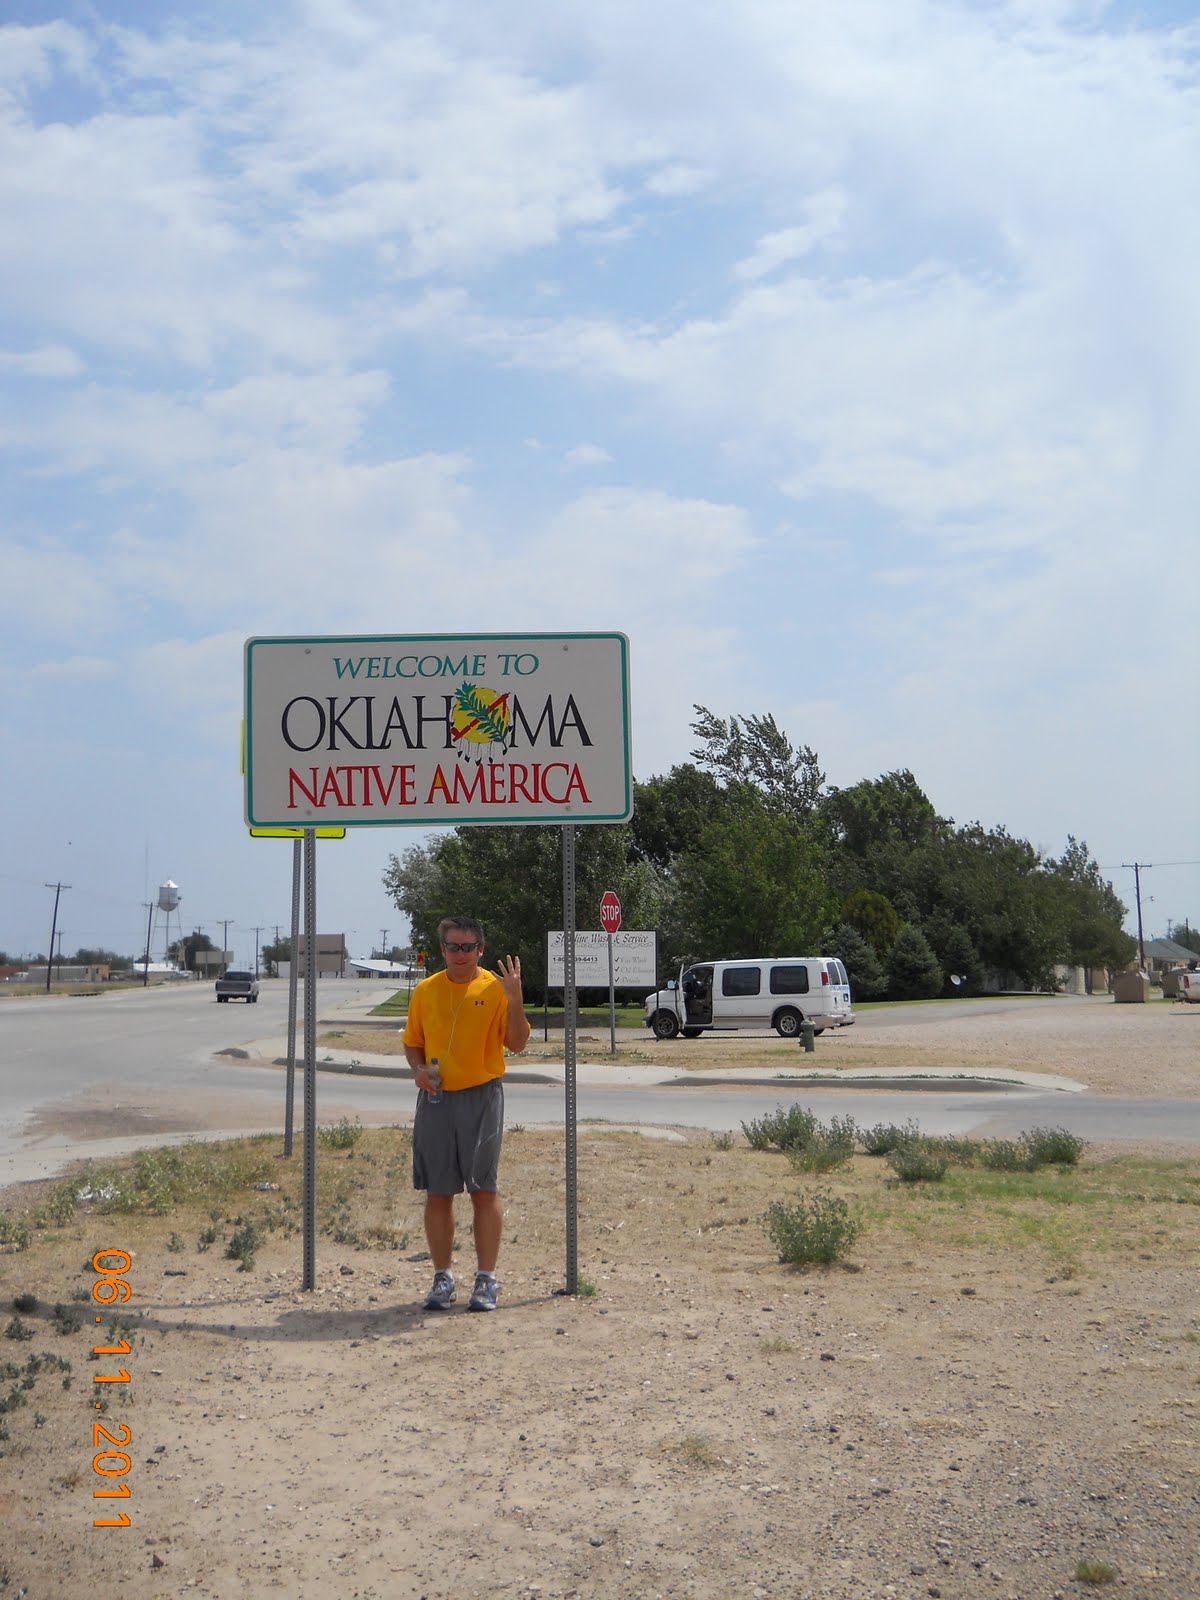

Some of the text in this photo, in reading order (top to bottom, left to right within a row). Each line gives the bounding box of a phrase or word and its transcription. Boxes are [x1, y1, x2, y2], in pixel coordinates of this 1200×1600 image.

[333, 653, 540, 680] WELCOME TO
[287, 763, 592, 809] NATIVE AMERICA
[602, 905, 620, 921] STOP
[591, 933, 611, 943] Was
[622, 933, 649, 943] Service
